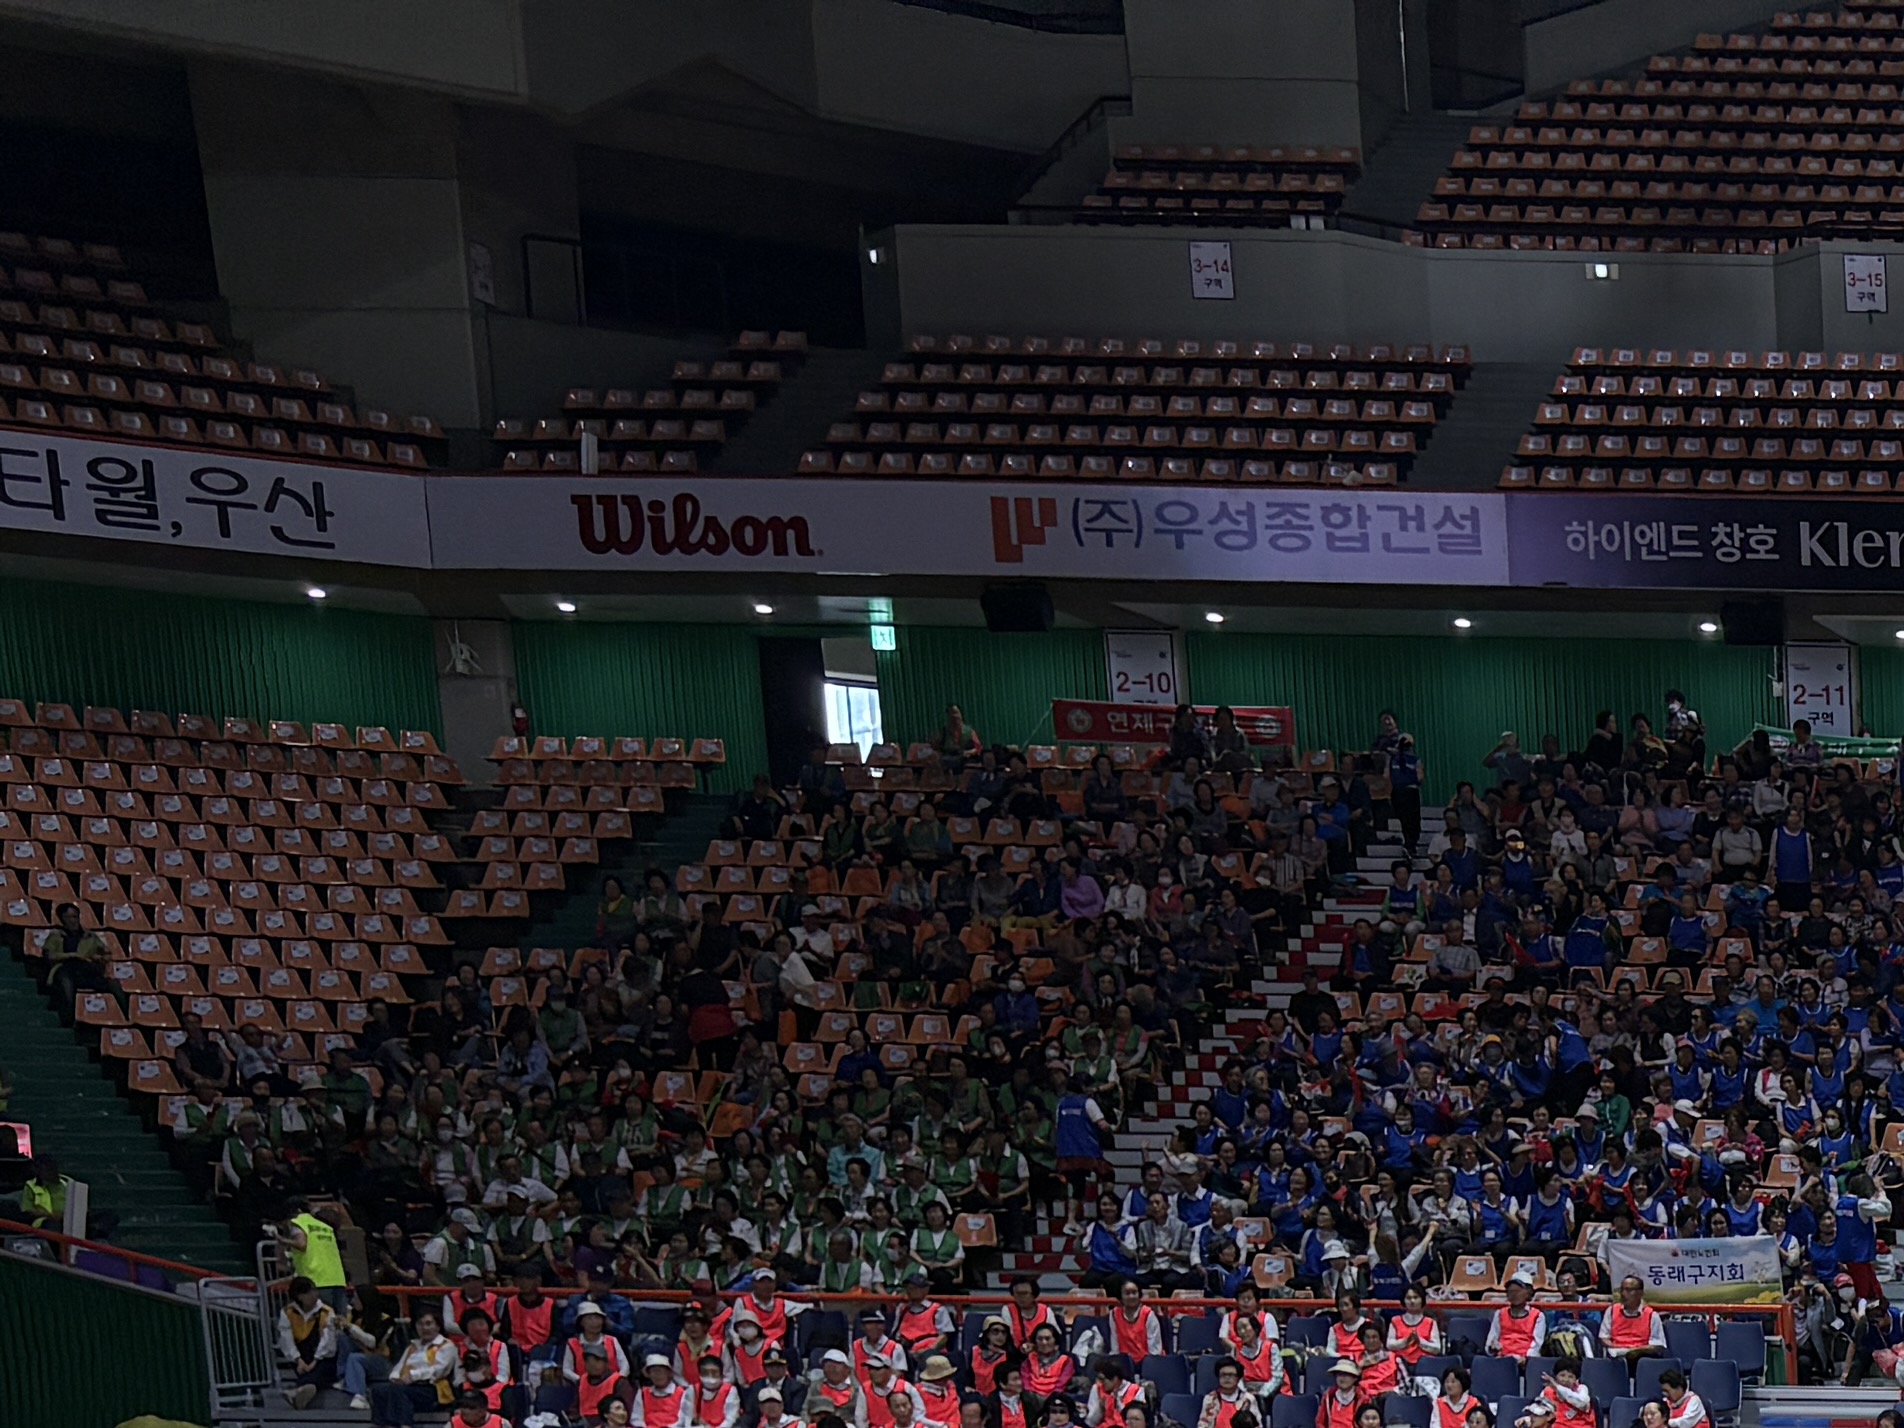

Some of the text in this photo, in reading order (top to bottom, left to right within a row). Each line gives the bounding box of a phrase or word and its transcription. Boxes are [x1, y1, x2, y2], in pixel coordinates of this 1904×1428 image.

[1193, 257, 1229, 274] 3-14
[1847, 271, 1884, 288] 3-15
[0, 447, 336, 549] 타월,우산
[570, 492, 824, 557] Wilson
[1071, 497, 1483, 556] (주)우성종합건설
[1564, 520, 1704, 561] 하이엔드
[1710, 521, 1780, 564] 창호
[1115, 671, 1171, 694] 2-10
[1792, 683, 1846, 706] 2-11
[1647, 1262, 1744, 1287] 동래구지회
